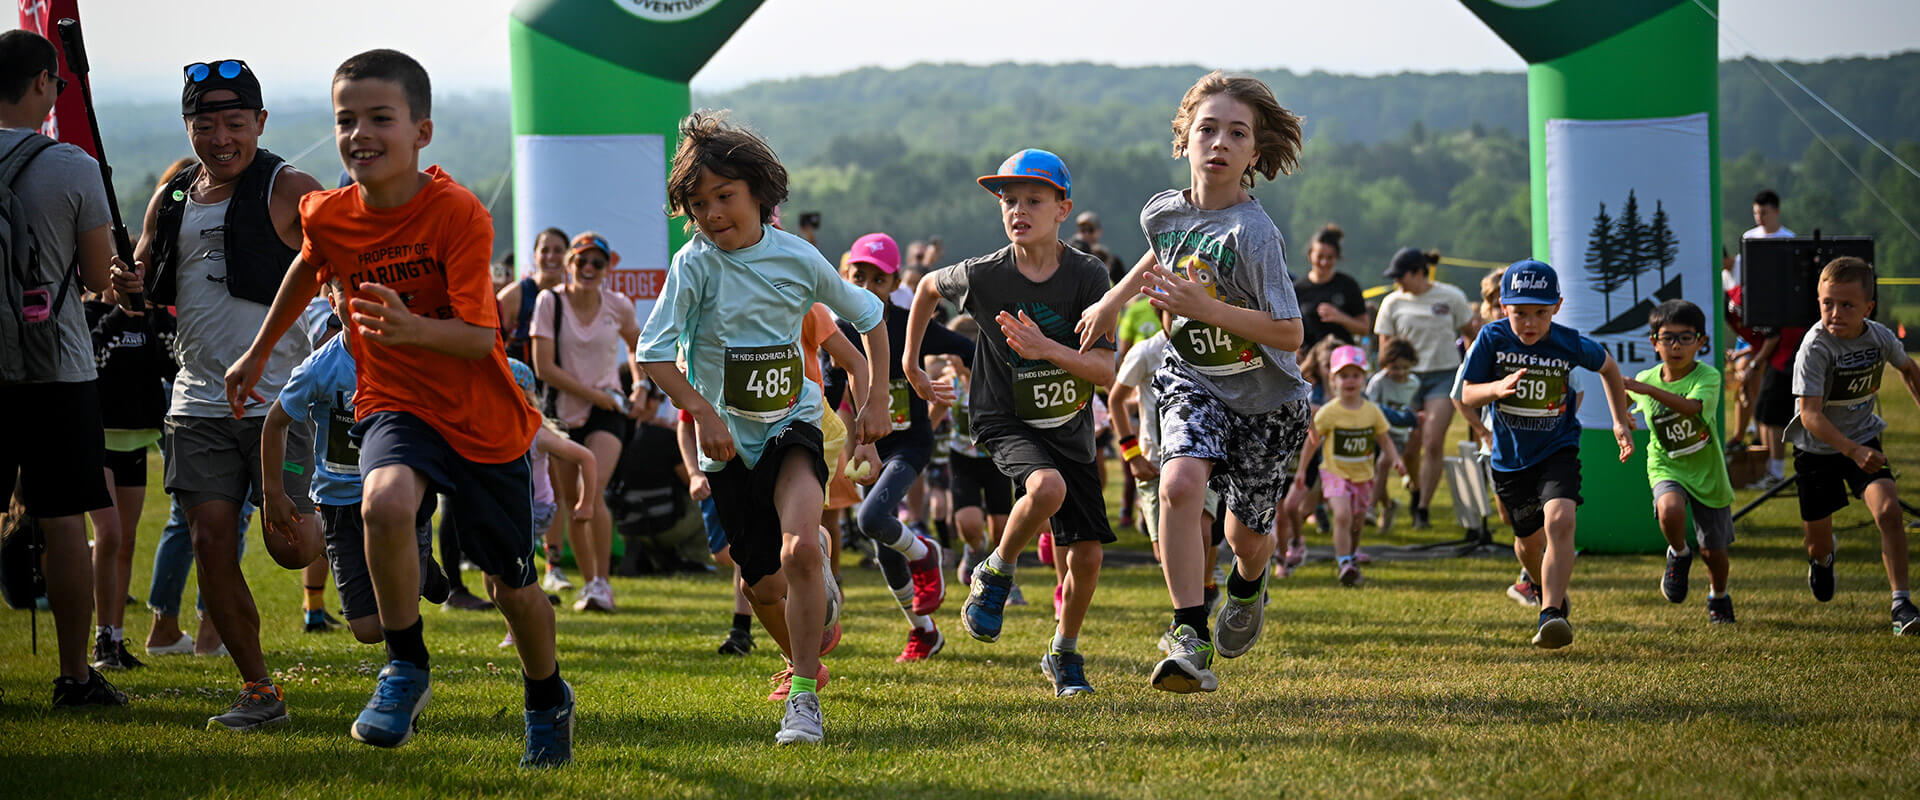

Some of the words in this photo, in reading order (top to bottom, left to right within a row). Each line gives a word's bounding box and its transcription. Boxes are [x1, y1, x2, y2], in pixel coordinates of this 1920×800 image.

[414, 242, 429, 256] OF
[1188, 326, 1233, 355] 514
[746, 366, 792, 399] 485
[1033, 379, 1077, 409] 526
[1515, 379, 1547, 401] 519
[1847, 374, 1873, 393] 471
[1665, 419, 1697, 443] 492
[1342, 437, 1367, 453] 470
